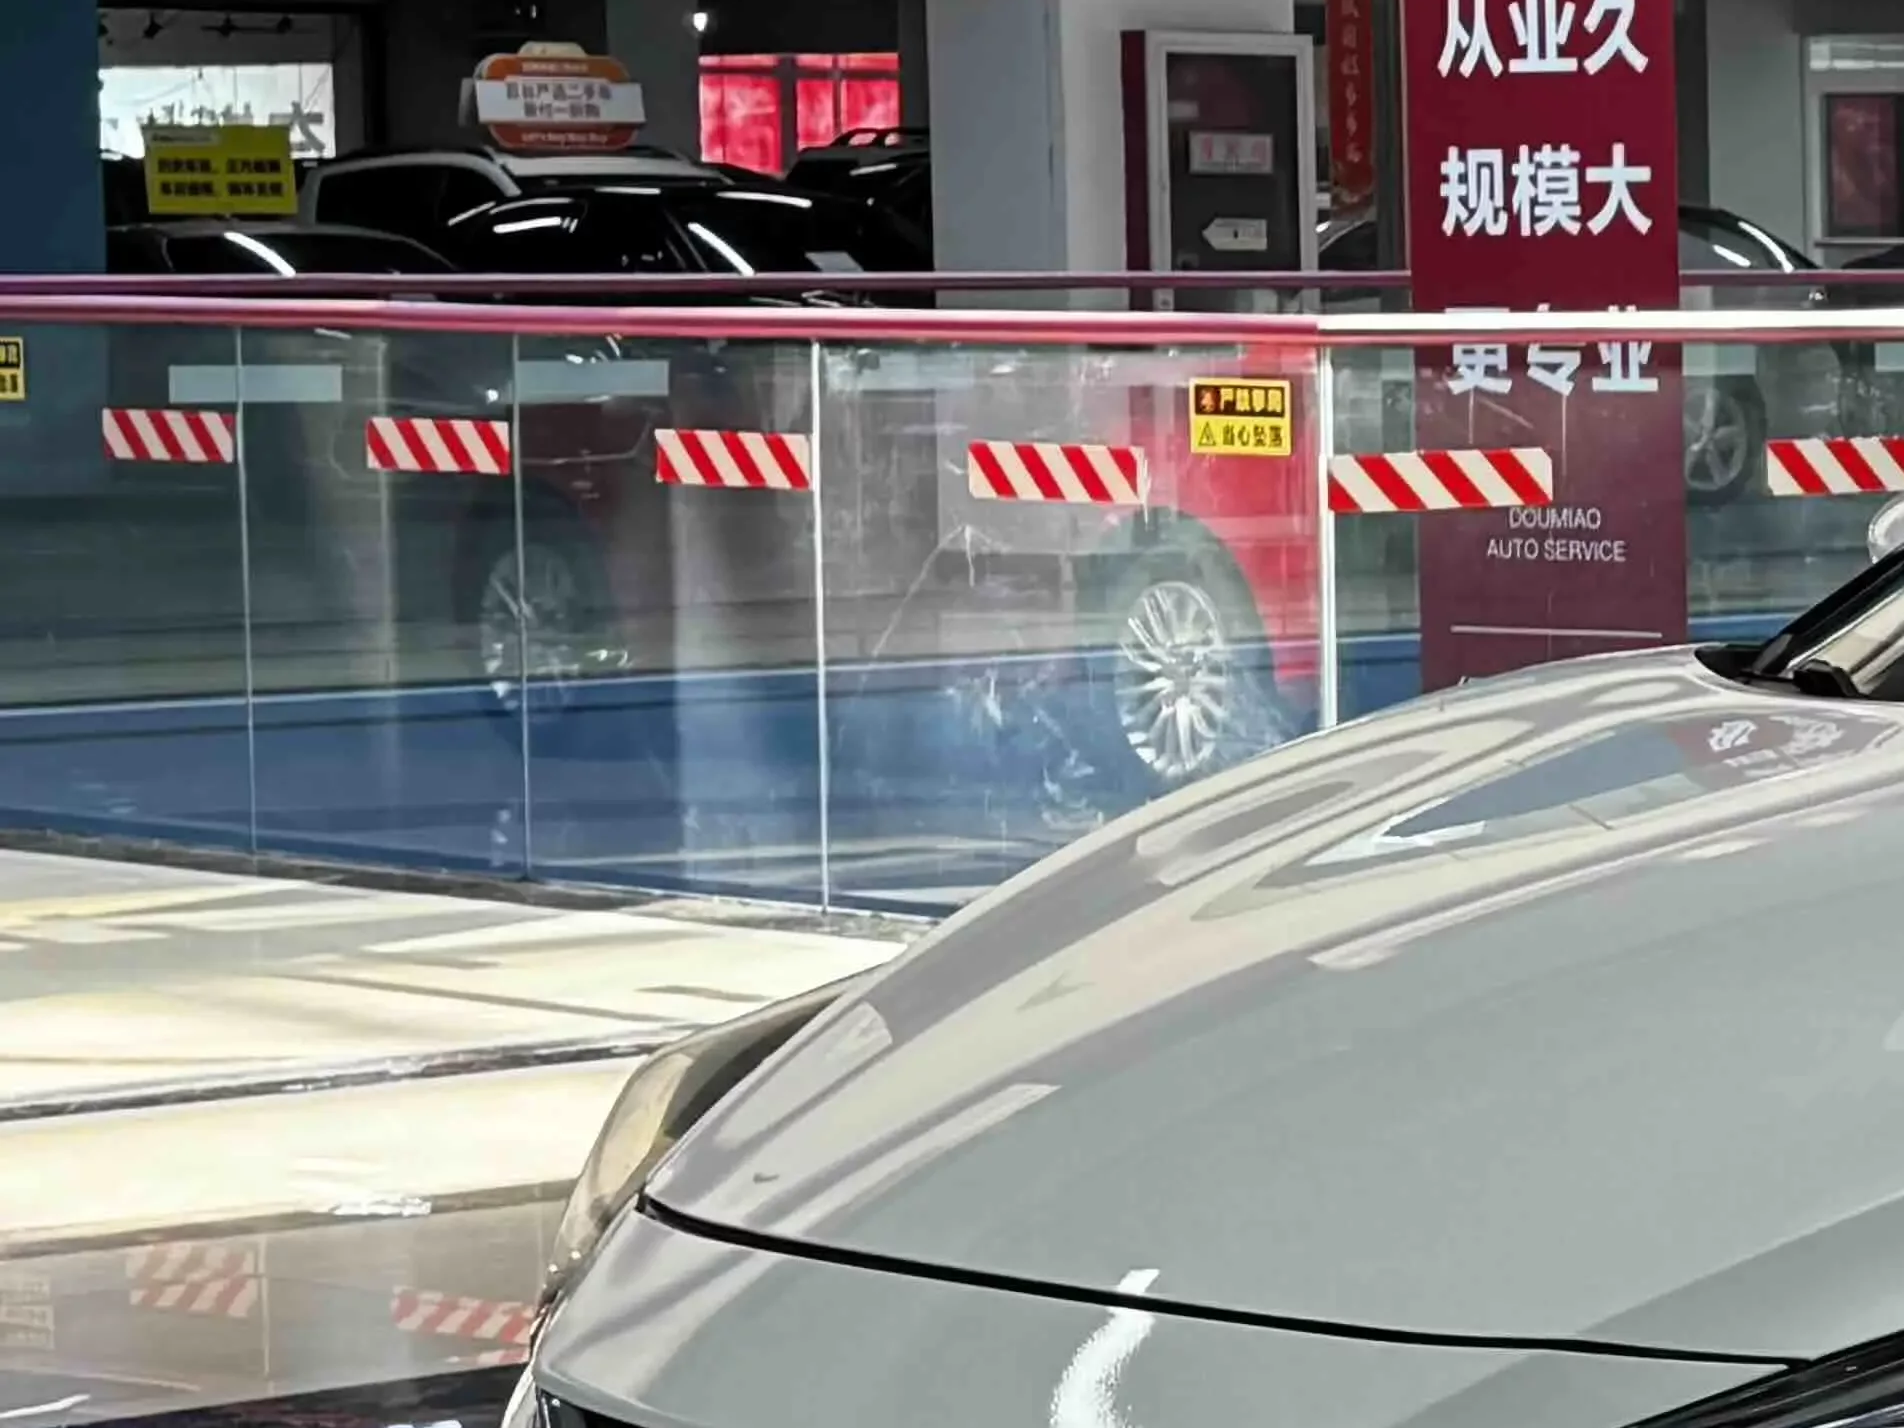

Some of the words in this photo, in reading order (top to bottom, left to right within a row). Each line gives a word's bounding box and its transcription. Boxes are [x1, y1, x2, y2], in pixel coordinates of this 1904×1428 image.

[1440, 142, 1653, 237] 规模大
[1445, 302, 1660, 397] 更专业
[1508, 506, 1602, 529] DOUMIAO
[1486, 538, 1539, 560] AUTO
[1543, 539, 1627, 563] SERVICE
